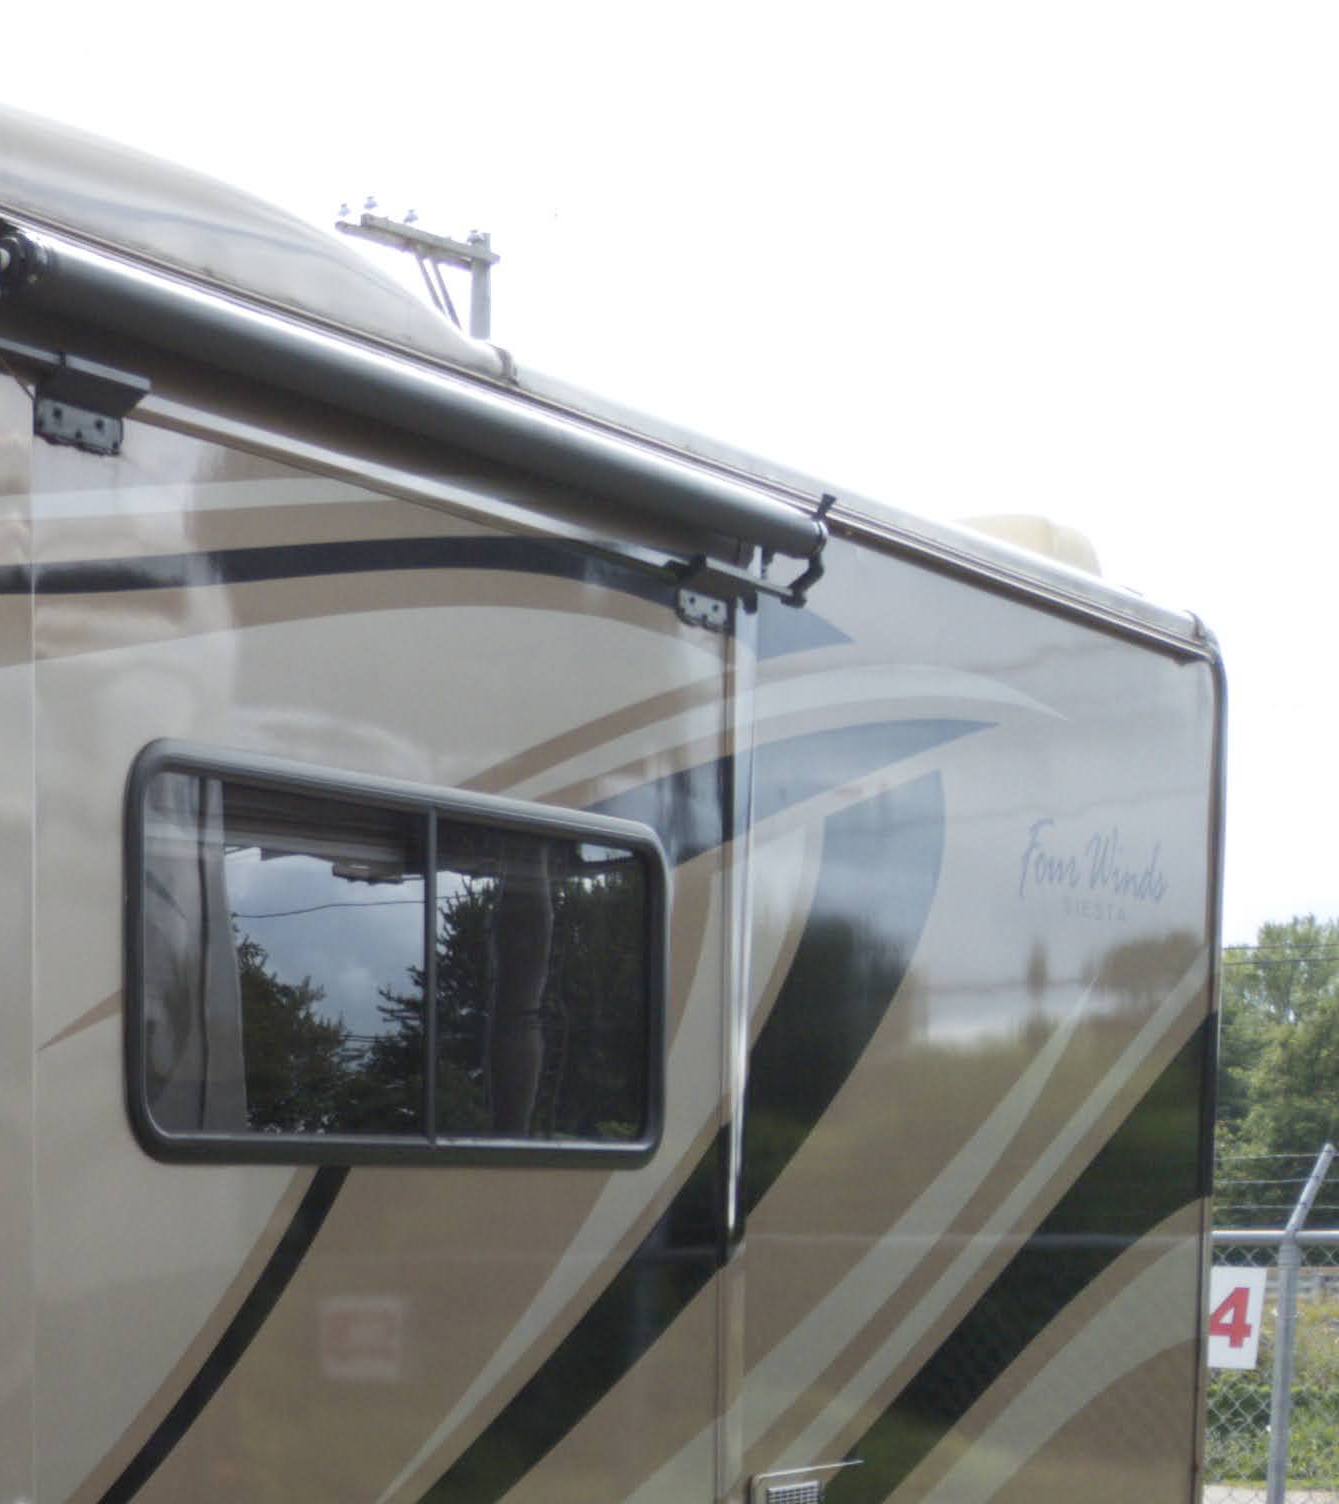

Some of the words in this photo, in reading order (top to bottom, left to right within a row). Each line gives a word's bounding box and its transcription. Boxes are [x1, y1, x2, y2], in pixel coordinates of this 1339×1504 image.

[1018, 816, 1081, 899] Four
[1083, 824, 1170, 903] Winds
[1208, 1286, 1253, 1348] 4
